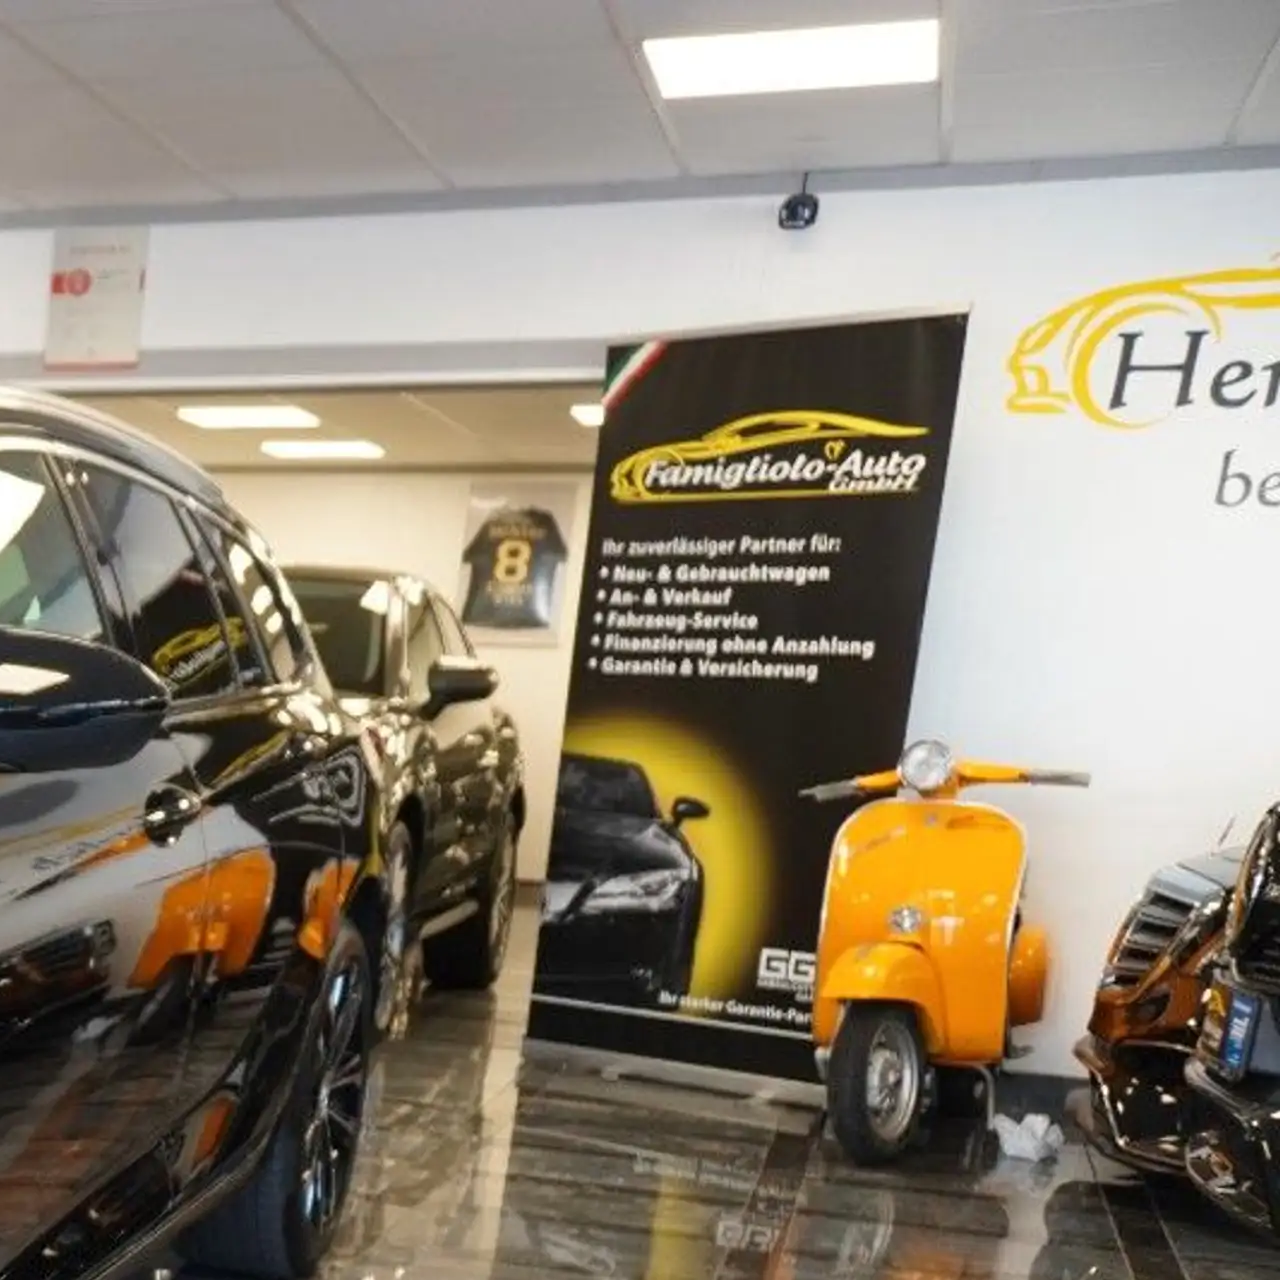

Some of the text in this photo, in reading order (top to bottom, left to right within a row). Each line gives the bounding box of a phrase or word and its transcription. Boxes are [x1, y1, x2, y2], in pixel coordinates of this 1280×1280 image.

[602, 533, 841, 558] Ihr zuverlässiger Partner für:
[494, 539, 531, 582] 8
[612, 563, 830, 586] Neu- & Gebrauchtwagen
[609, 586, 732, 605] An- & Verkauf
[606, 611, 759, 631] Fahrzeug-Service
[603, 633, 875, 660] Finanzierung ohne Anzahlung
[601, 656, 819, 682] Garantie & Versicherung
